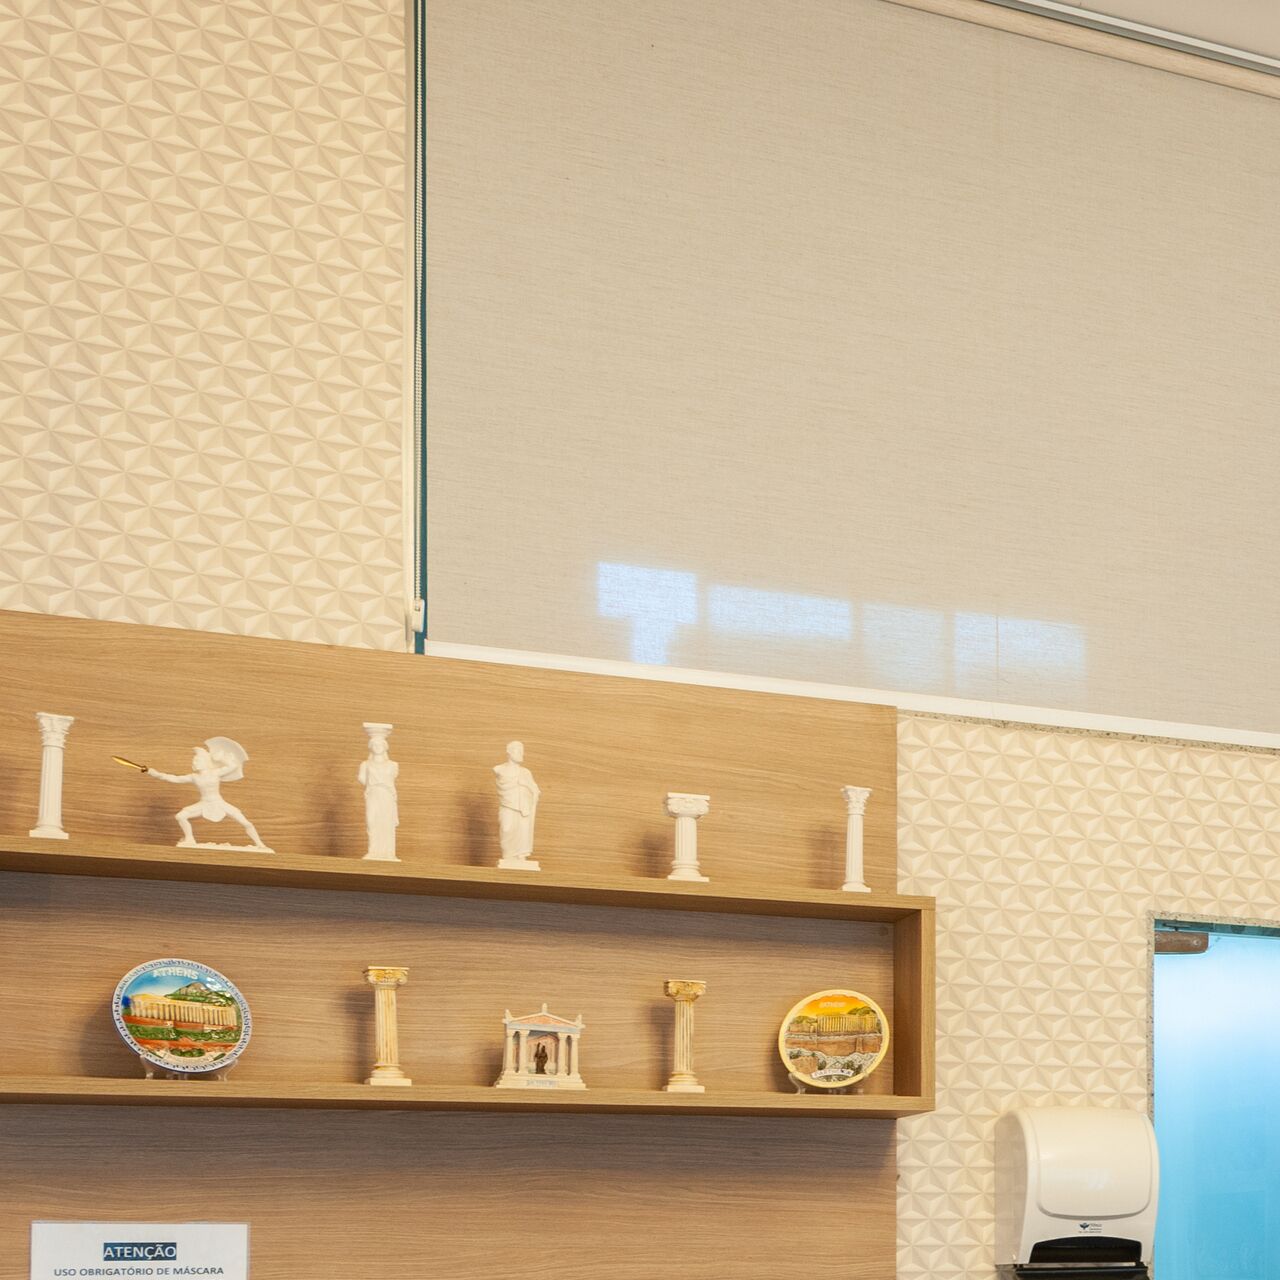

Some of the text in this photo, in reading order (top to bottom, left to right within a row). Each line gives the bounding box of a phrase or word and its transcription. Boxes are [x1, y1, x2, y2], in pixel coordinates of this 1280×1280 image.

[152, 967, 200, 980] ATHENS
[104, 1244, 176, 1260] ATENÇÃO
[54, 1268, 77, 1276] USO
[80, 1266, 153, 1276] OBRIGATÓRIO
[173, 1265, 224, 1275] MÁSCARA
